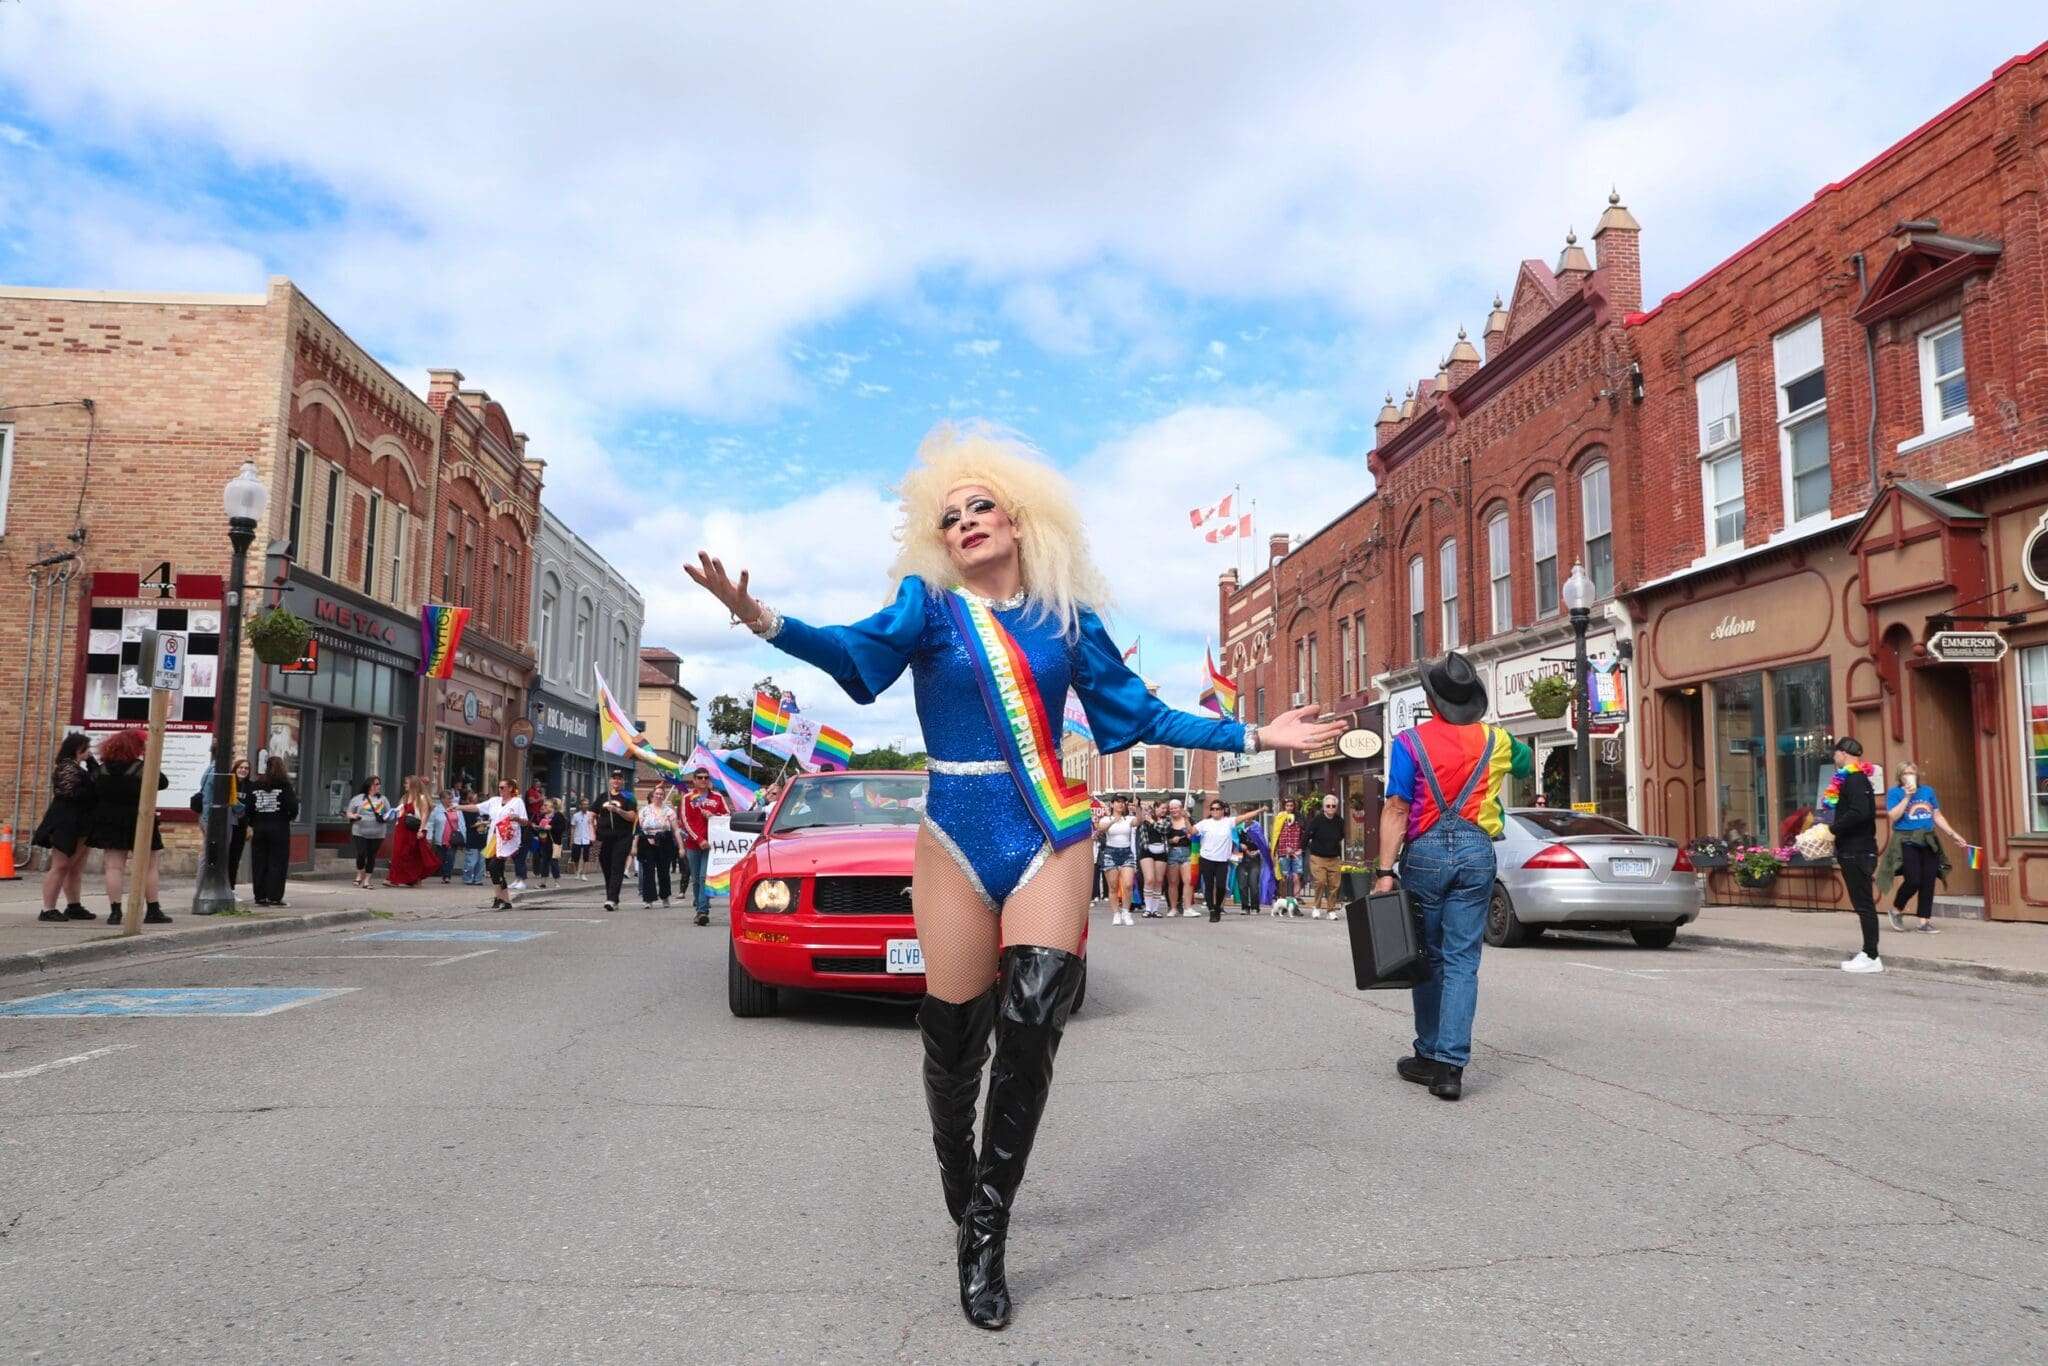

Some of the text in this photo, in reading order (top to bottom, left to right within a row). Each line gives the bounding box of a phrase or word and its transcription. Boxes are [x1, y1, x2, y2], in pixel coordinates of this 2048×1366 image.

[141, 562, 174, 598] 4
[1711, 616, 1755, 639] Adorn
[1942, 638, 1995, 647] EMMERSON
[981, 627, 1026, 708] DURHAM
[1010, 716, 1047, 784] PRIDE
[547, 708, 587, 738] RBC Royal Bank
